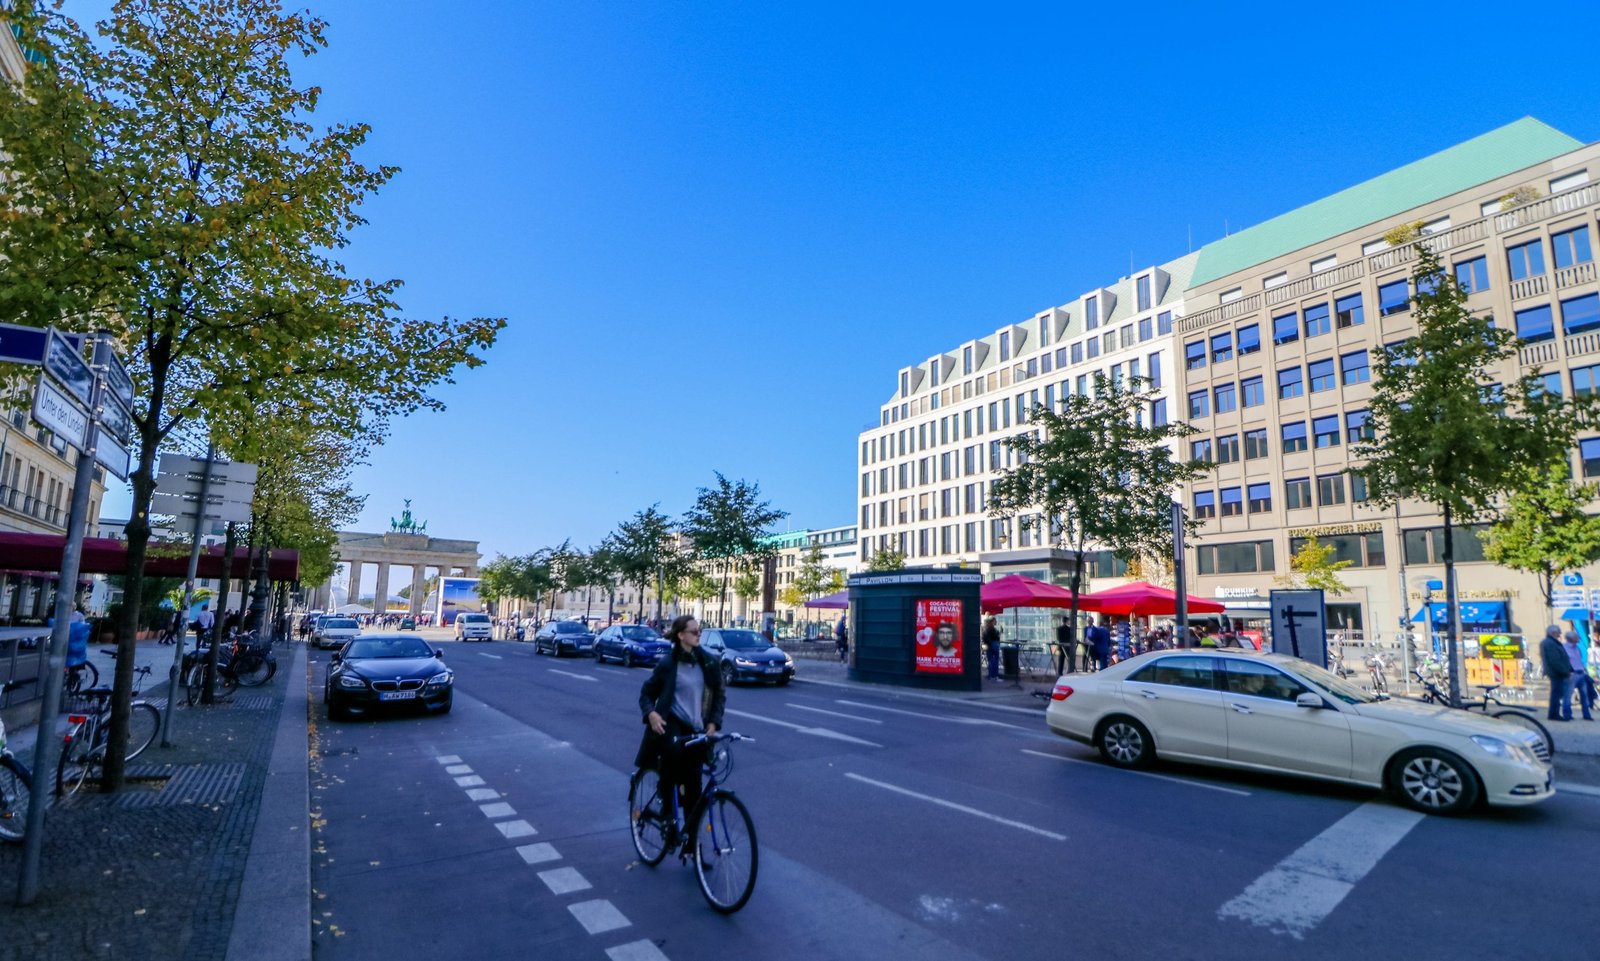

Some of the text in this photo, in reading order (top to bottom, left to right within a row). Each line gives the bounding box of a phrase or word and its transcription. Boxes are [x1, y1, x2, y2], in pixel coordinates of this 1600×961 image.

[41, 388, 57, 416] Unter
[57, 404, 68, 424] den
[67, 410, 84, 435] Linden
[1356, 521, 1383, 532] HAUS
